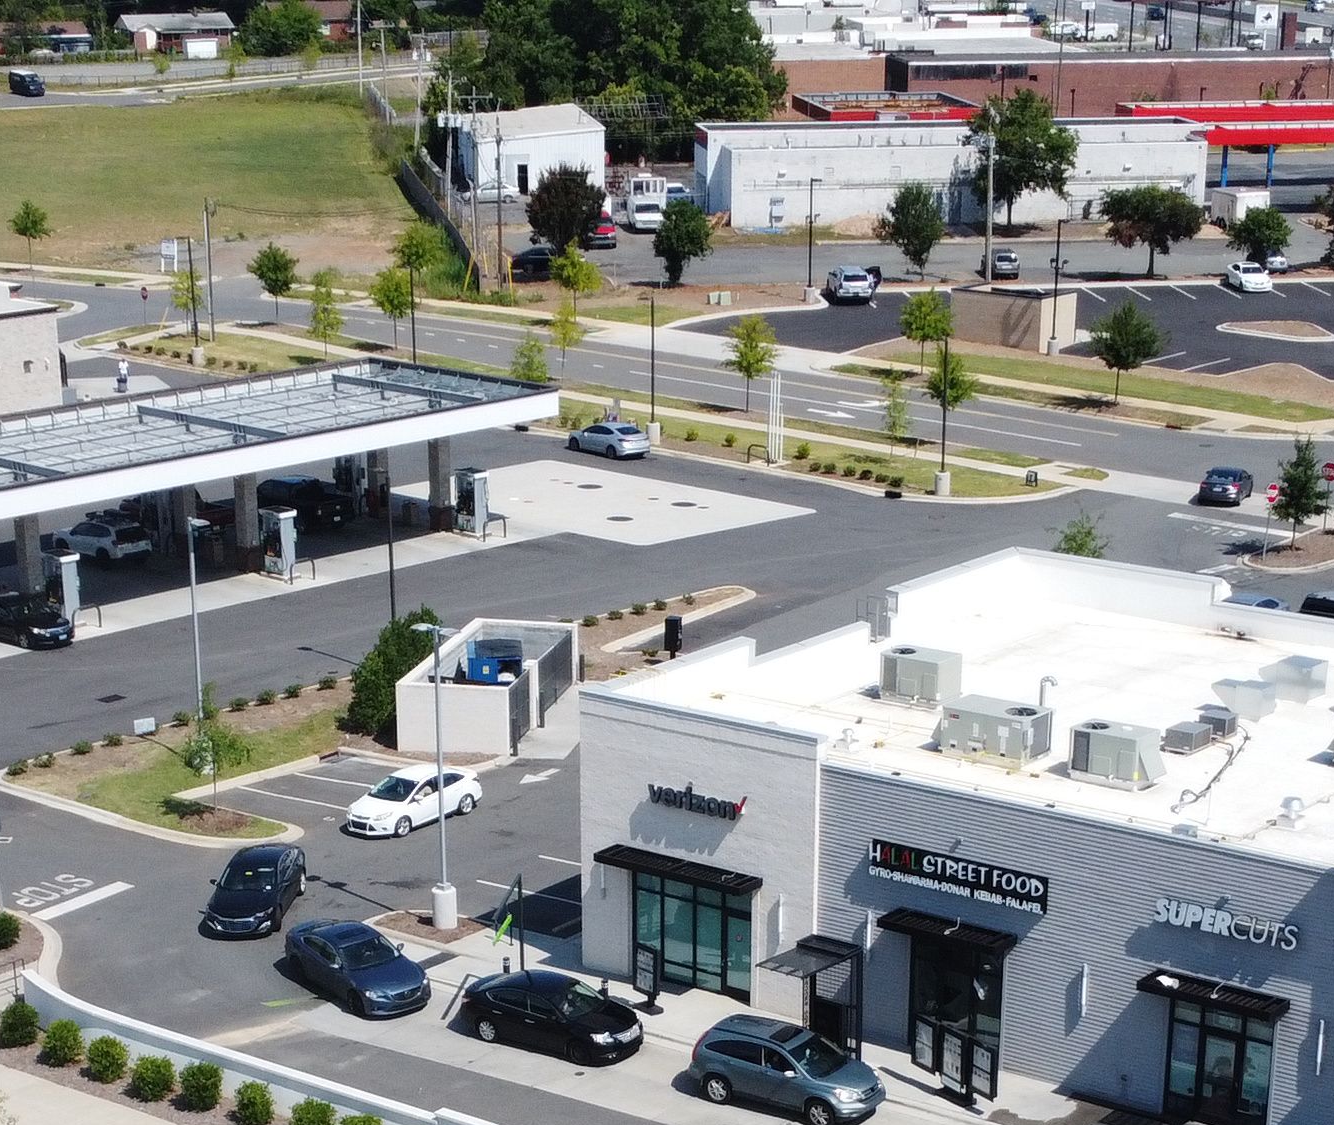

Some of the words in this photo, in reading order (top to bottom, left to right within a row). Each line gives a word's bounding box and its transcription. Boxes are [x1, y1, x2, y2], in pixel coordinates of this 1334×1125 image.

[648, 782, 737, 821] verizon
[12, 873, 95, 908] STOP
[868, 842, 920, 870] HALAL
[922, 854, 989, 885] STREET
[992, 869, 1045, 897] FOOD
[1153, 898, 1299, 951] SUPERCUTS
